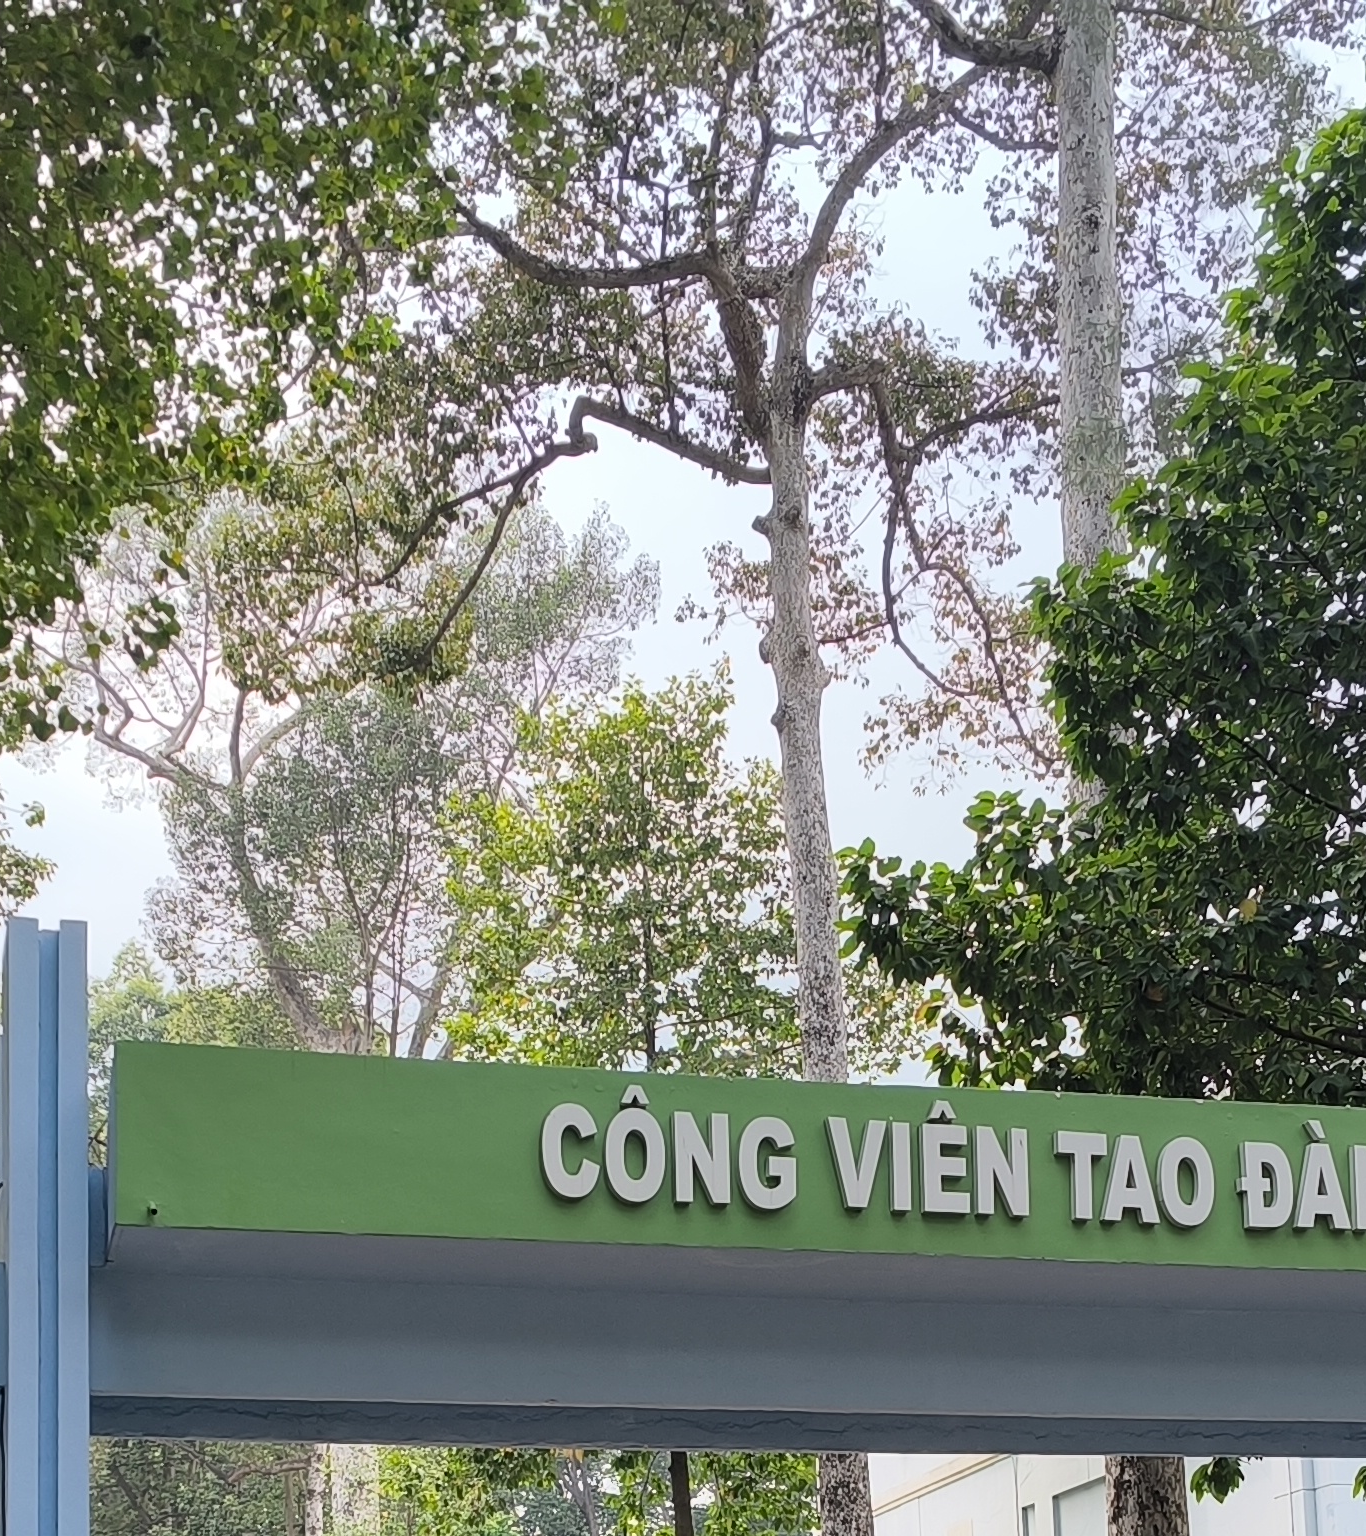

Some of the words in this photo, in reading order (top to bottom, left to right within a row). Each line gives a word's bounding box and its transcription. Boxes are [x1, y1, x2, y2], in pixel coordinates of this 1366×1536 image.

[540, 1084, 797, 1211] CÔNG
[825, 1101, 1029, 1218] VIÊN
[1053, 1130, 1215, 1228] TAO
